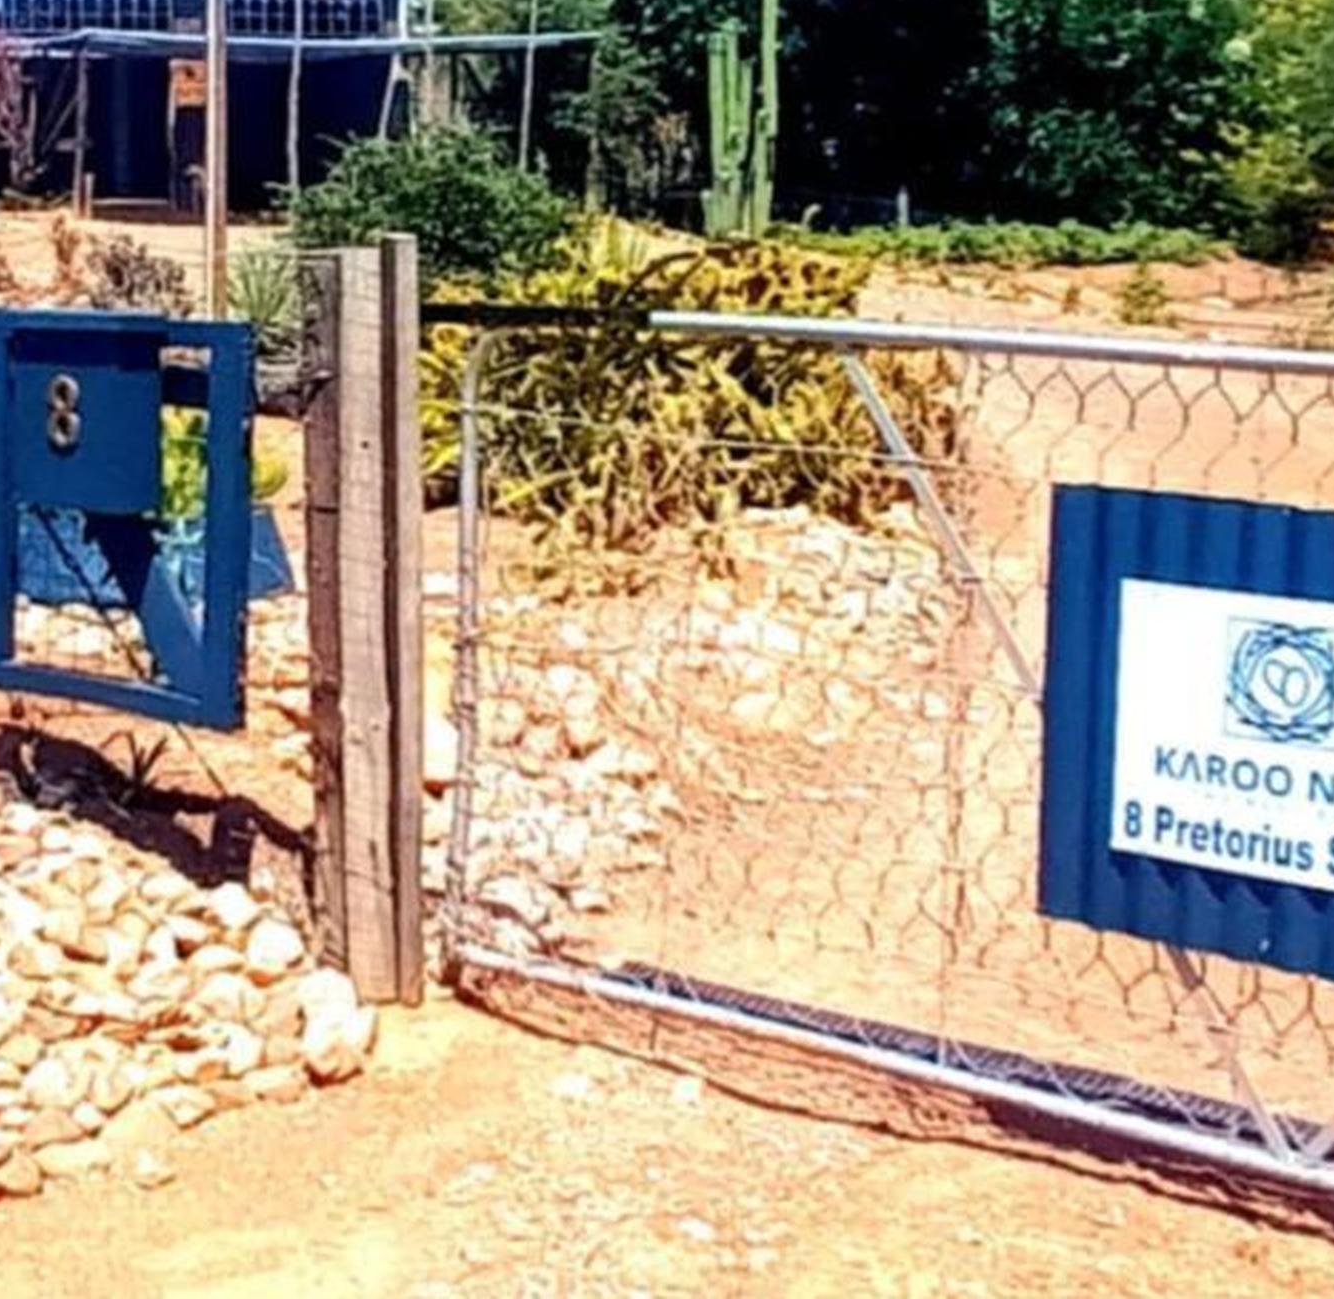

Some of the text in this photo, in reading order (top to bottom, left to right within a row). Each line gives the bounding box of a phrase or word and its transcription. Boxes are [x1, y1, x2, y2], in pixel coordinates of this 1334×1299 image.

[47, 373, 80, 447] 8
[1155, 746, 1293, 797] KAROO
[1124, 801, 1142, 838] 8
[1154, 806, 1314, 871] Pretorius
